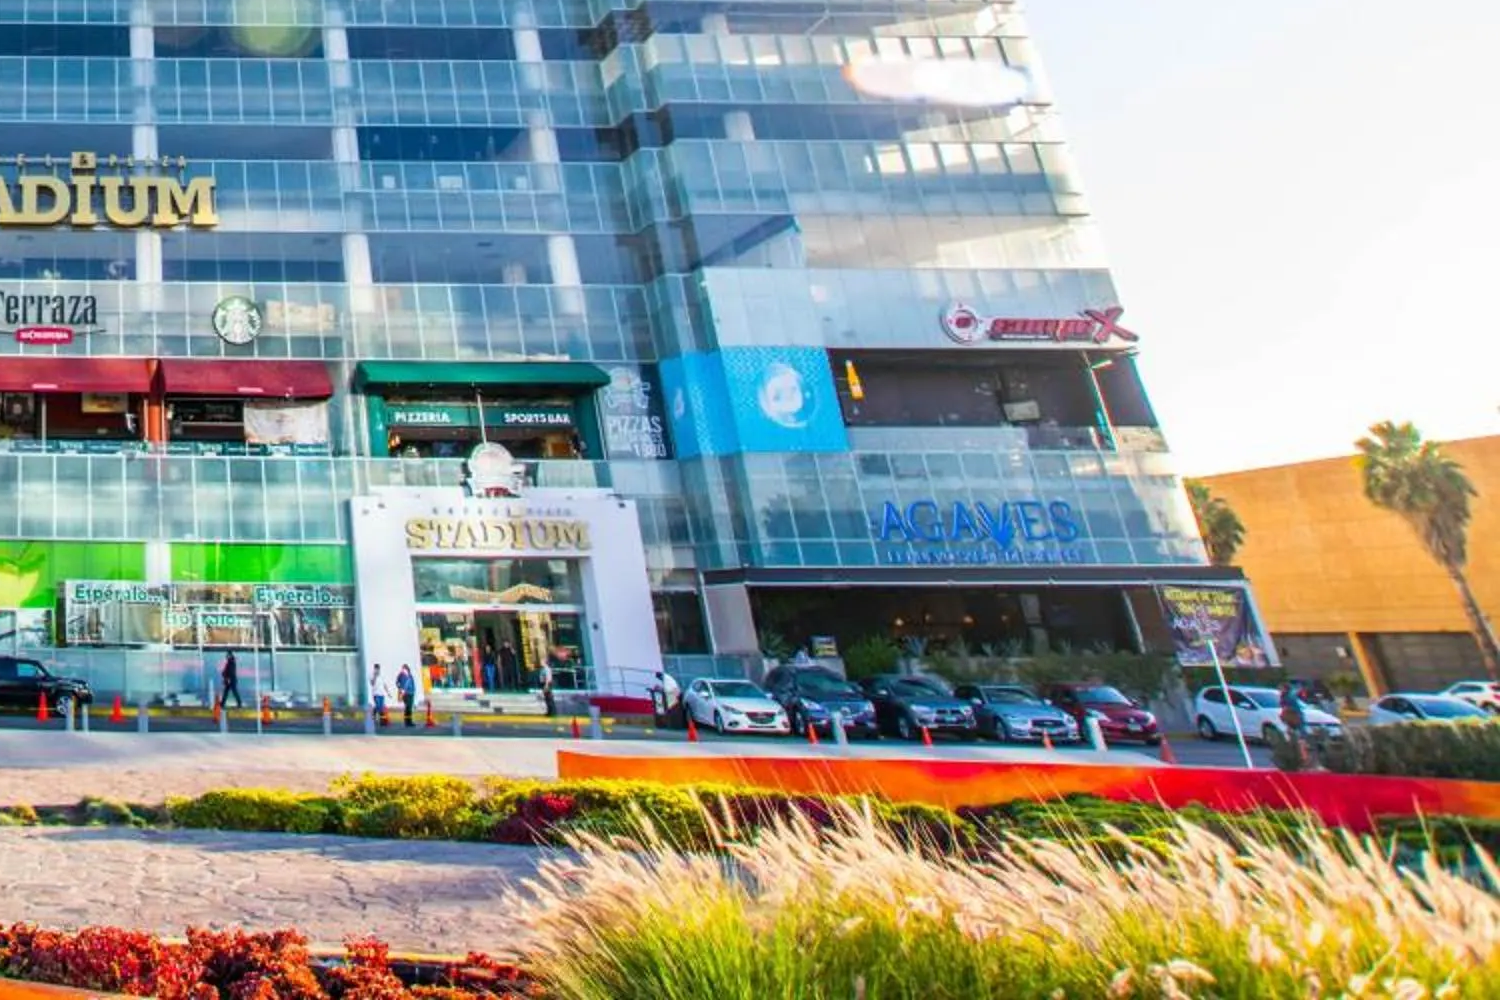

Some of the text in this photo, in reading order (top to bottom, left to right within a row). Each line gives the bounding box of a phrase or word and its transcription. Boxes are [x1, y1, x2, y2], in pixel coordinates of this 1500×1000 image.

[394, 412, 450, 423] PIZZERIA
[504, 412, 546, 424] SPORTS
[405, 517, 591, 550] STADIUM
[881, 499, 1080, 548] AGAVES
